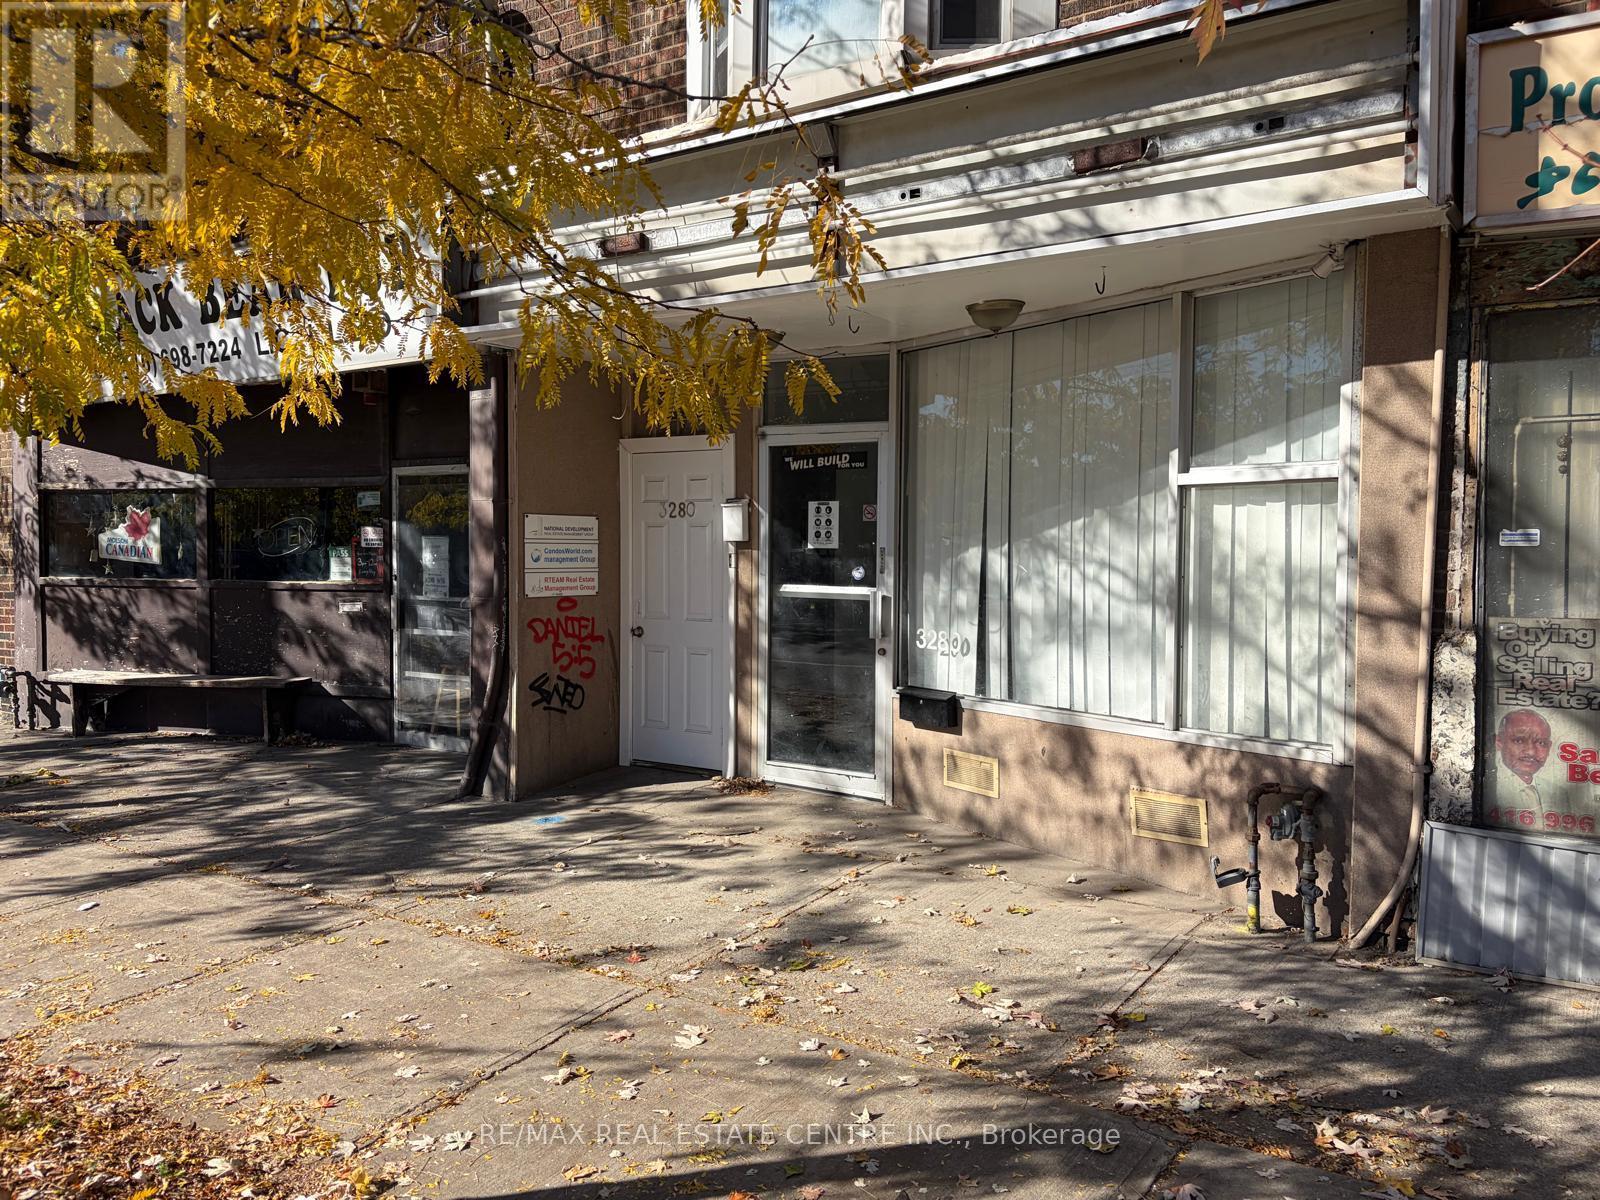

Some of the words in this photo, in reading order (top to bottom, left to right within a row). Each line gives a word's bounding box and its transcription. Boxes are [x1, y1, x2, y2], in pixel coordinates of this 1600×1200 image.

[790, 458, 815, 471] WILL
[817, 453, 850, 467] BUILD
[659, 501, 695, 518] 3280
[106, 543, 153, 558] CANADIAN
[332, 549, 349, 558] PASS
[544, 556, 579, 564] management
[579, 556, 596, 564] Group
[527, 616, 605, 643] DANIEL
[1498, 622, 1596, 649] Buying
[1505, 640, 1540, 658] Or
[1497, 655, 1593, 681] Selling
[1513, 673, 1577, 693] Real
[1497, 688, 1600, 710] Estate?
[1488, 806, 1536, 826] 416
